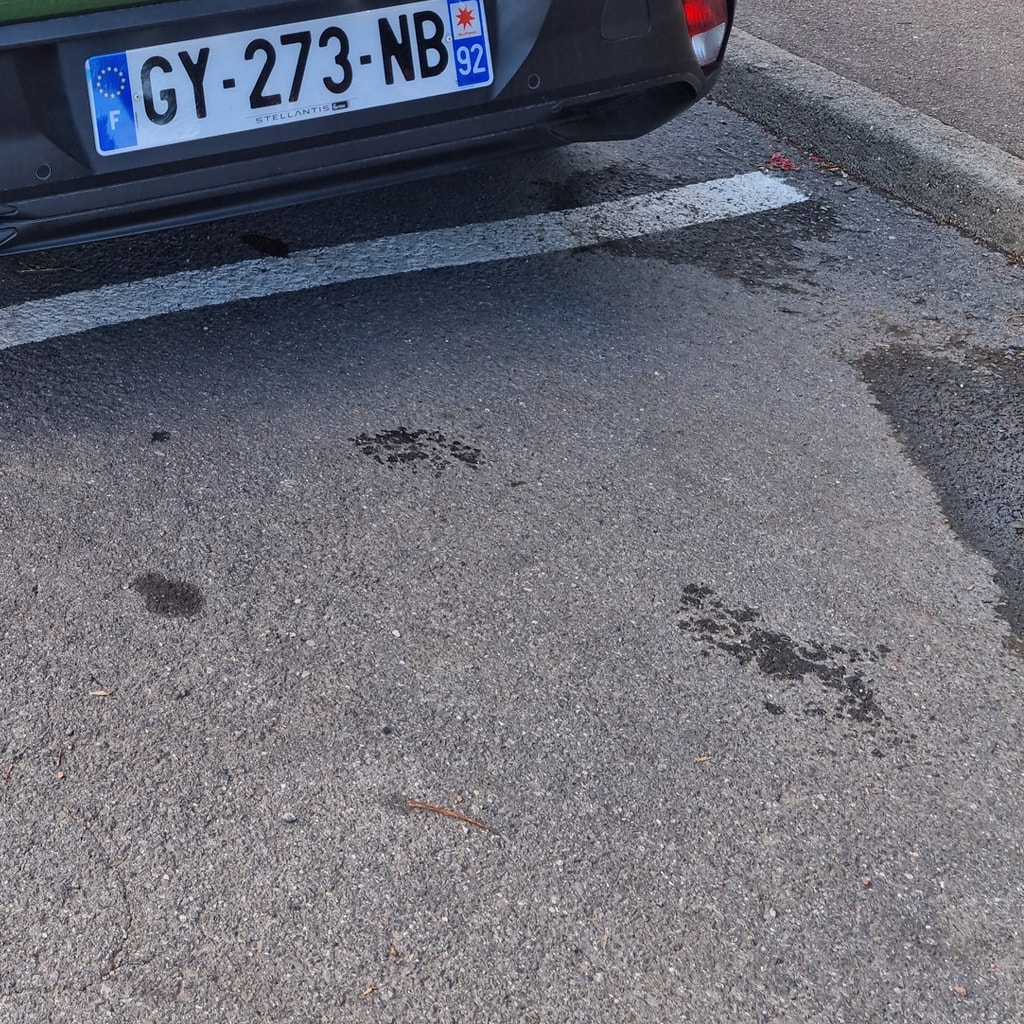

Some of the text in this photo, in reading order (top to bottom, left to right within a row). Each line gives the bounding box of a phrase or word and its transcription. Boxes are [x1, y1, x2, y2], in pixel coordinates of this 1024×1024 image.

[140, 10, 449, 125] GY-273-NB
[456, 43, 486, 76] 92
[109, 109, 121, 131] F
[255, 104, 330, 124] STELLANTIS
